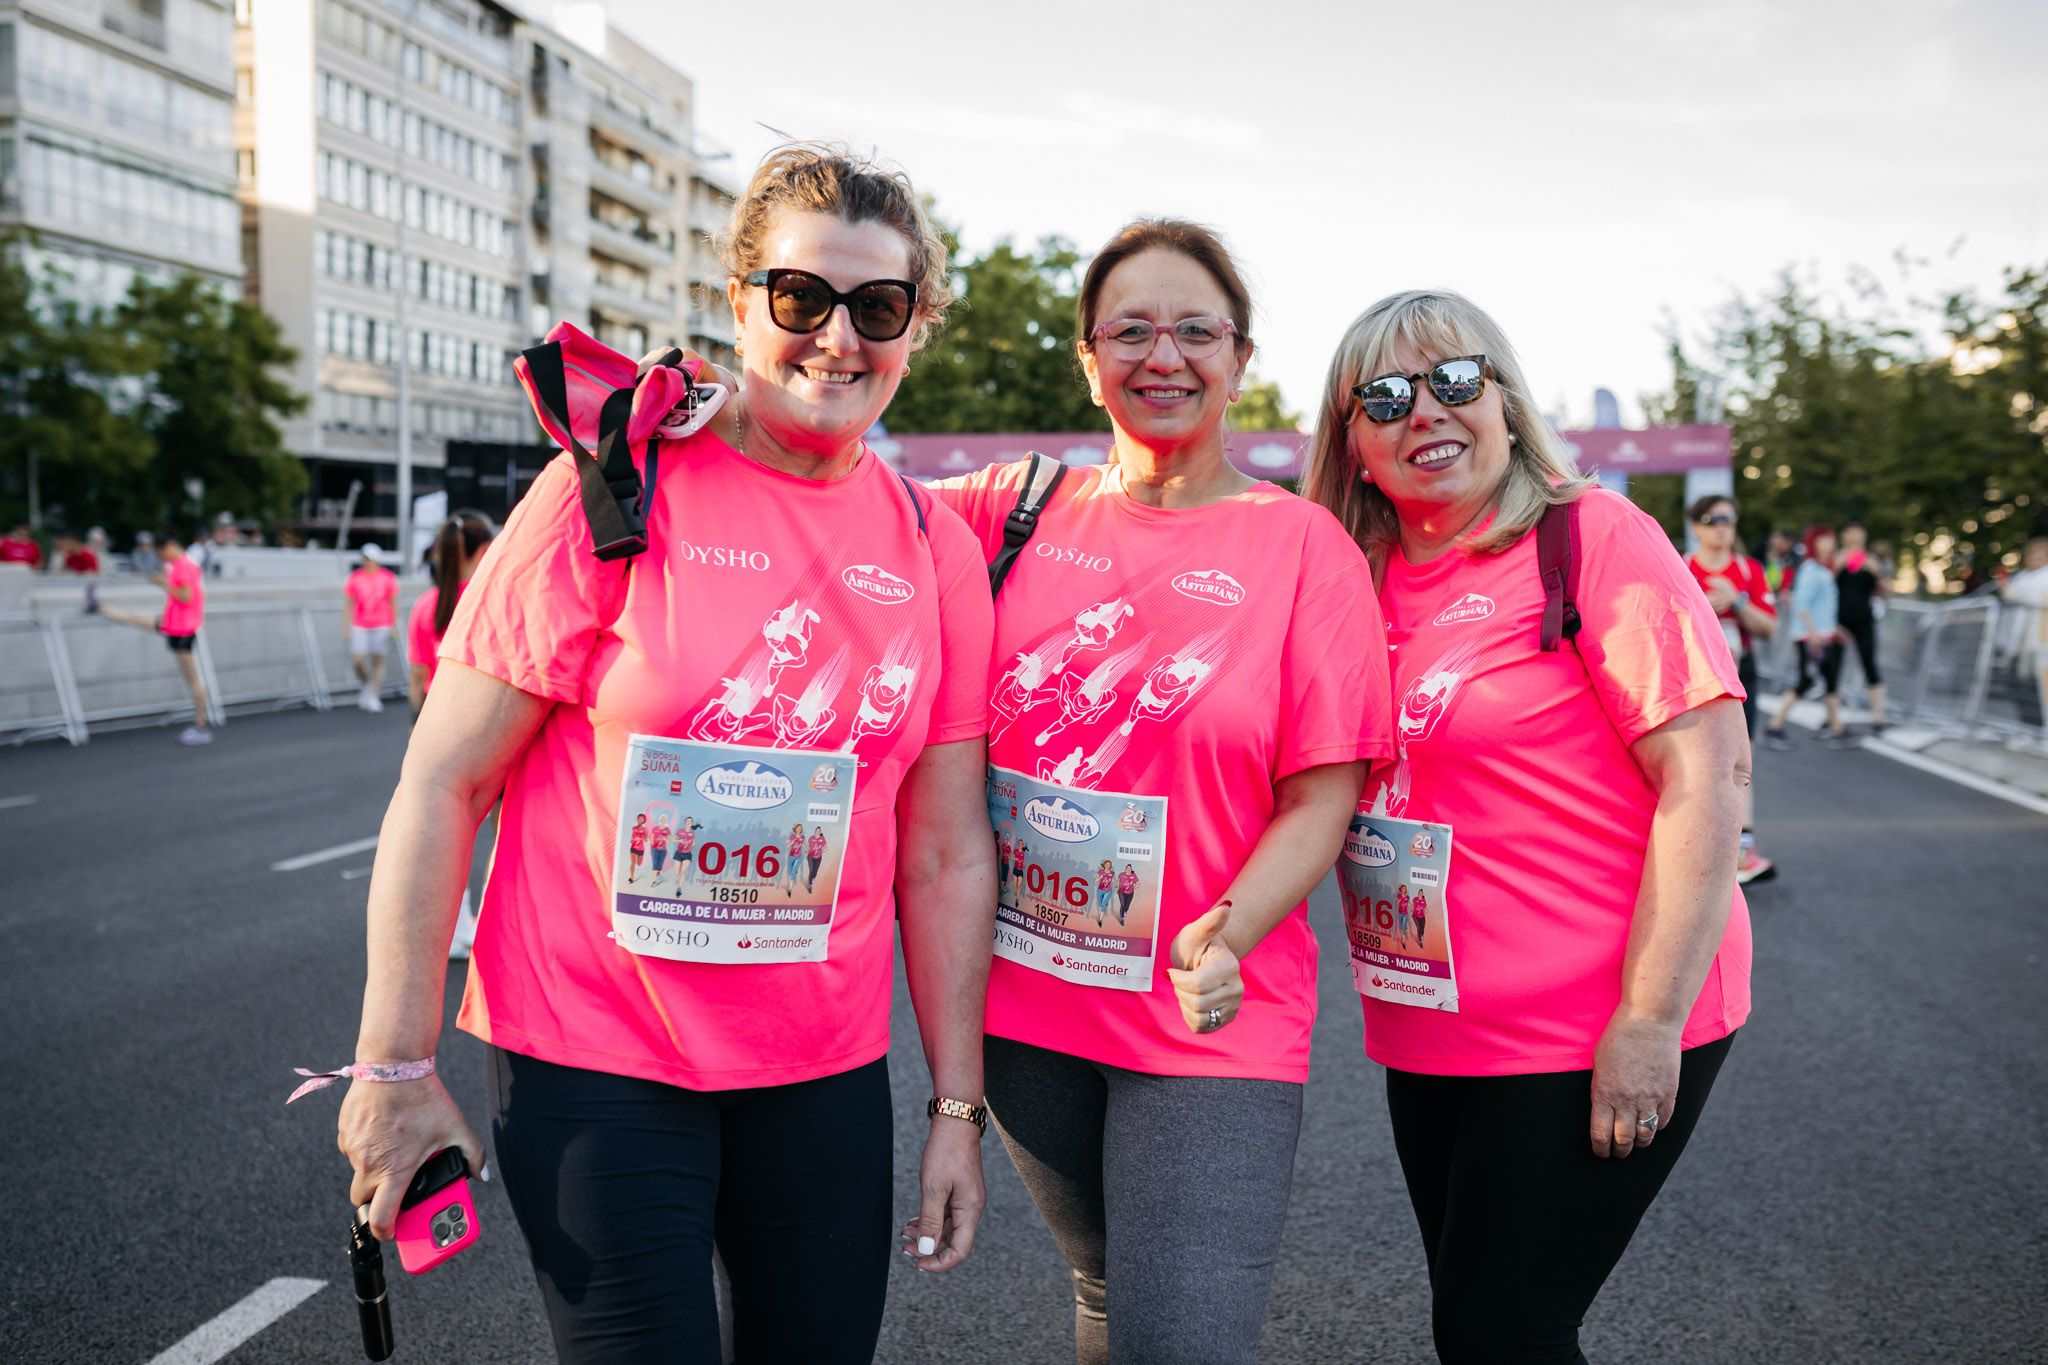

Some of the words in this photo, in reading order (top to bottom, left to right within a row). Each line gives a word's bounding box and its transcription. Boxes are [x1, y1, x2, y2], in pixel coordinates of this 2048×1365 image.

[681, 541, 770, 571] OYSHO
[1036, 542, 1112, 572] OYSHO
[848, 572, 909, 598] ASTURIANA
[1177, 576, 1240, 602] ASTURIANA
[641, 760, 680, 773] SUMA
[702, 774, 787, 799] ASTURIANA
[1028, 805, 1093, 836] ASTURIANA
[1414, 835, 1432, 850] 20
[698, 841, 780, 878] 016
[710, 886, 758, 903] 18510
[1026, 863, 1089, 907] 016
[639, 900, 692, 917] CARRERA
[695, 906, 712, 918] DE
[714, 908, 729, 920] LA
[732, 908, 766, 921] MUJER
[774, 909, 814, 921] MADRID
[1034, 903, 1069, 926] 18507
[636, 925, 710, 947] OYSHO
[997, 906, 1025, 926] ARRERA
[1026, 918, 1036, 930] DE
[1037, 923, 1046, 934] LA
[1047, 926, 1076, 943] MUJER
[1085, 936, 1128, 951] MADRID
[1352, 929, 1381, 949] 18509
[754, 936, 813, 949] Santander
[1066, 957, 1129, 976] Santander
[1365, 950, 1389, 965] MUJER
[1396, 958, 1430, 973] MADRID
[1383, 978, 1437, 996] Santander
